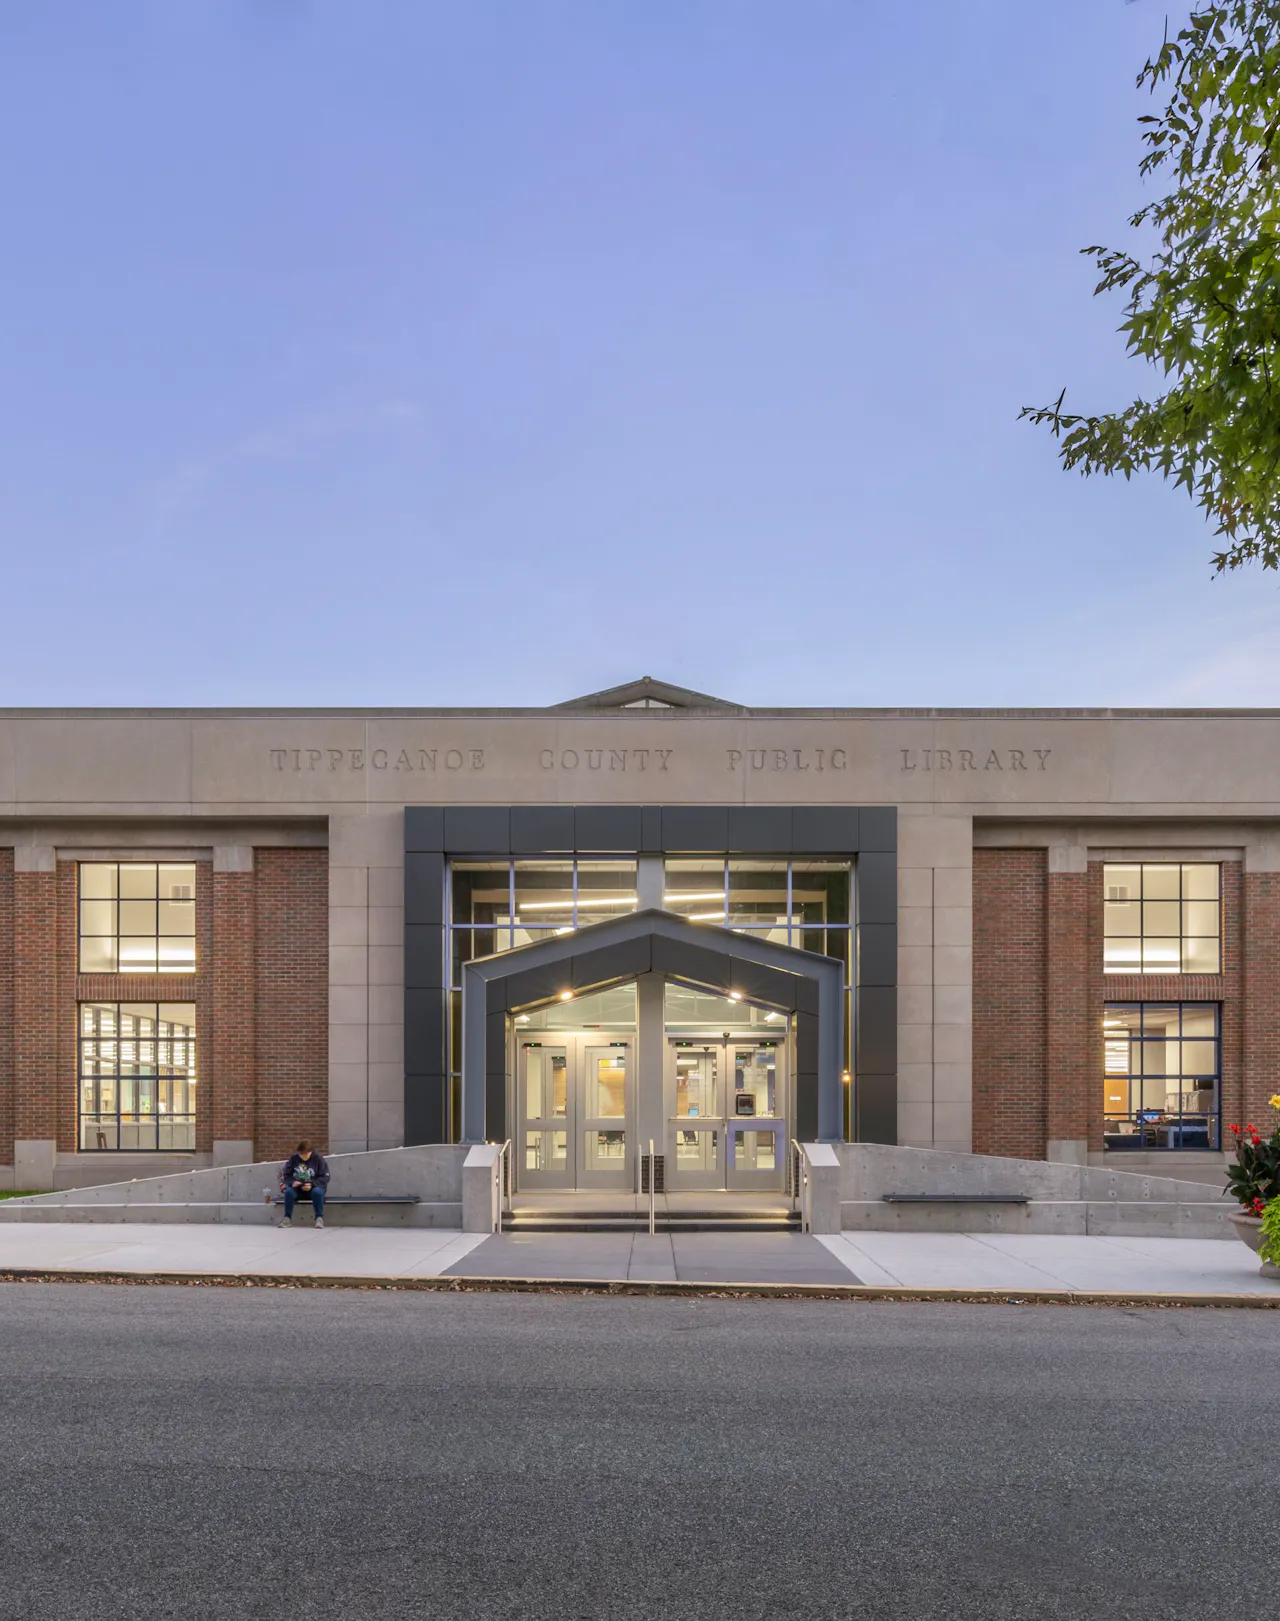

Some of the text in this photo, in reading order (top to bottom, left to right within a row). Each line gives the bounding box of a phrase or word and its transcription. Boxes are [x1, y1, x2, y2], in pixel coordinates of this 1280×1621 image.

[269, 749, 1053, 772] TIPPECANOE COUNTY PUBLIC LIBRARY
